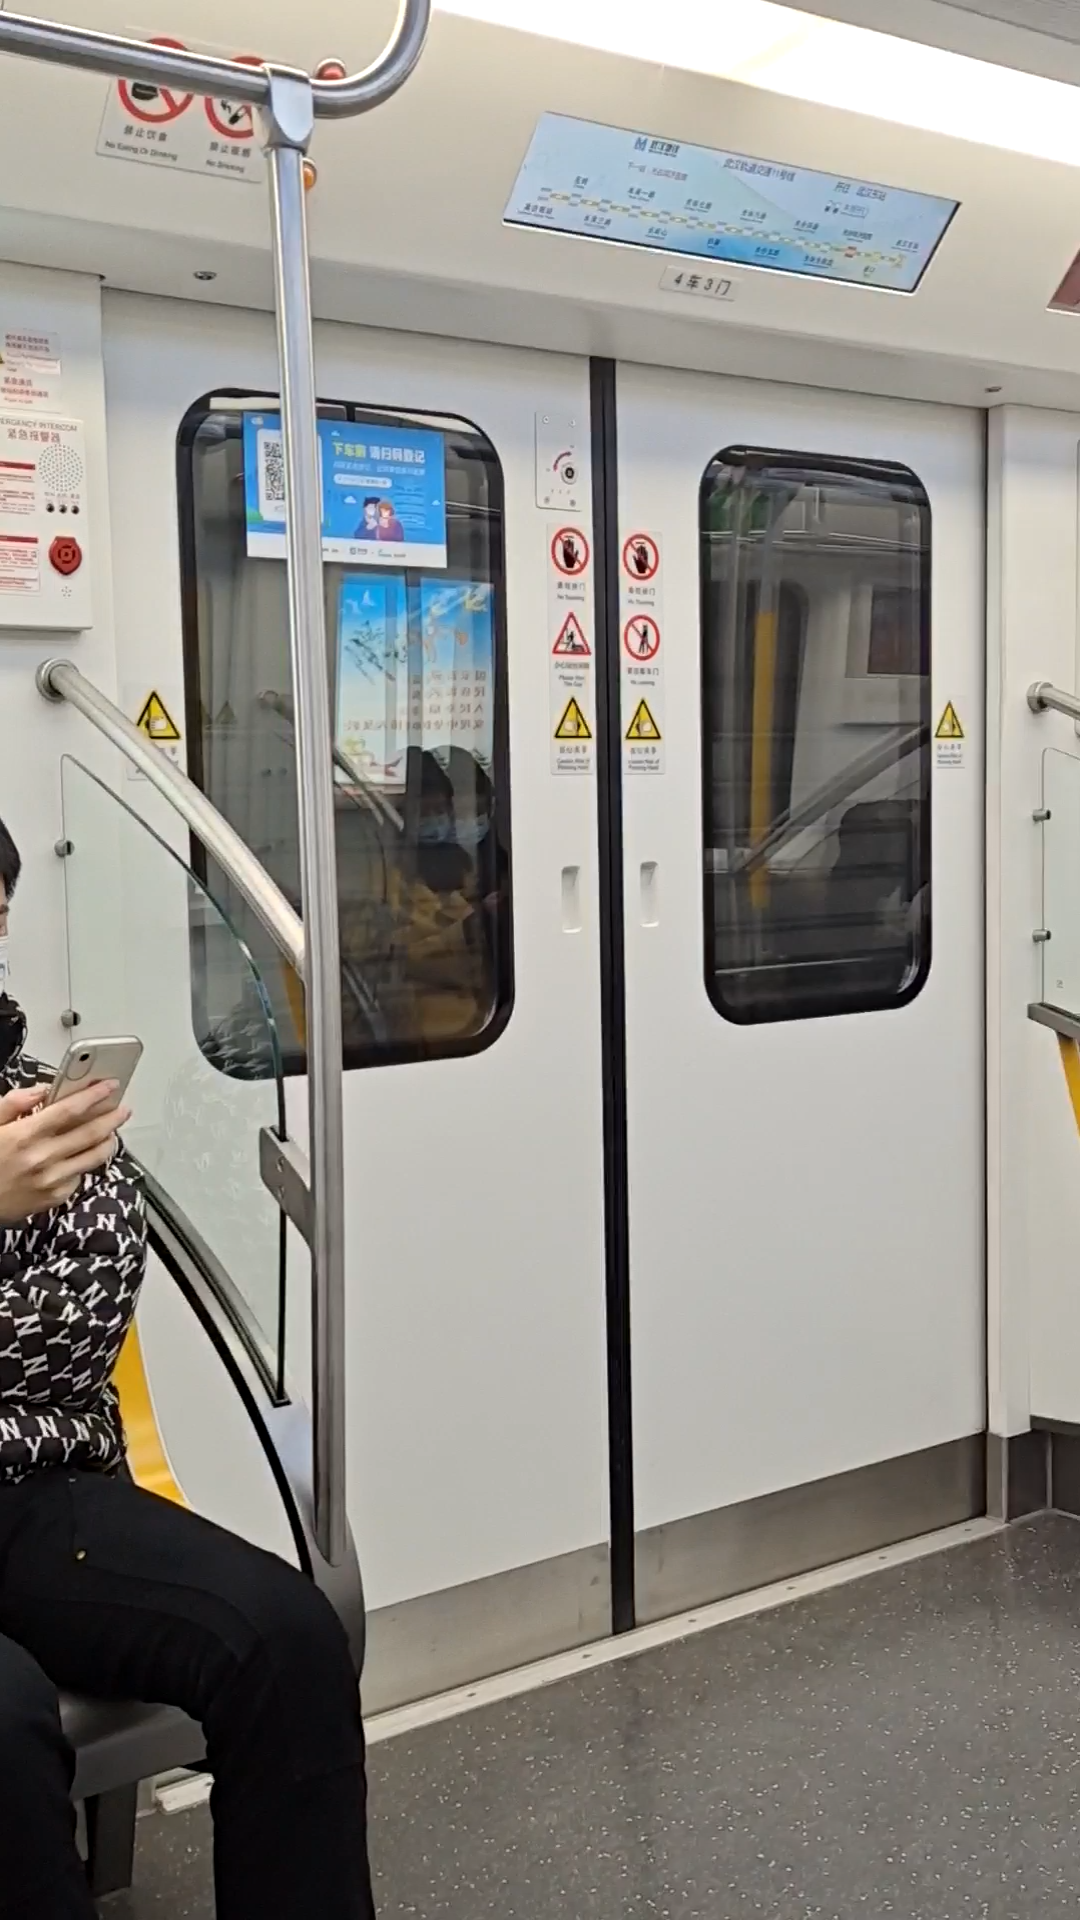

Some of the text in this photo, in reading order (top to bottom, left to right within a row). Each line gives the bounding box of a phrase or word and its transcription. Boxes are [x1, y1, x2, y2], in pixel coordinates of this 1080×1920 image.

[123, 125, 168, 142] 禁止饮食
[209, 141, 252, 158] 禁止吸烟
[674, 272, 732, 296] 4车3门
[7, 428, 60, 443] 紧急报警器
[97, 1214, 116, 1231] N
[5, 1230, 22, 1250] N
[76, 1227, 95, 1249] Y
[116, 1232, 131, 1256] Y
[48, 1257, 80, 1278] N
[29, 1286, 49, 1310] N
[79, 1280, 109, 1309] N
[14, 1313, 43, 1338] N
[46, 1328, 71, 1345] Y
[0, 1340, 22, 1360] Y
[71, 1336, 91, 1360] N
[23, 1353, 48, 1377] N
[51, 1363, 72, 1382] Y
[2, 1380, 28, 1398] Y
[72, 1369, 92, 1392] N
[0, 1417, 22, 1441] N
[35, 1416, 60, 1438] N
[24, 1436, 42, 1463] Y
